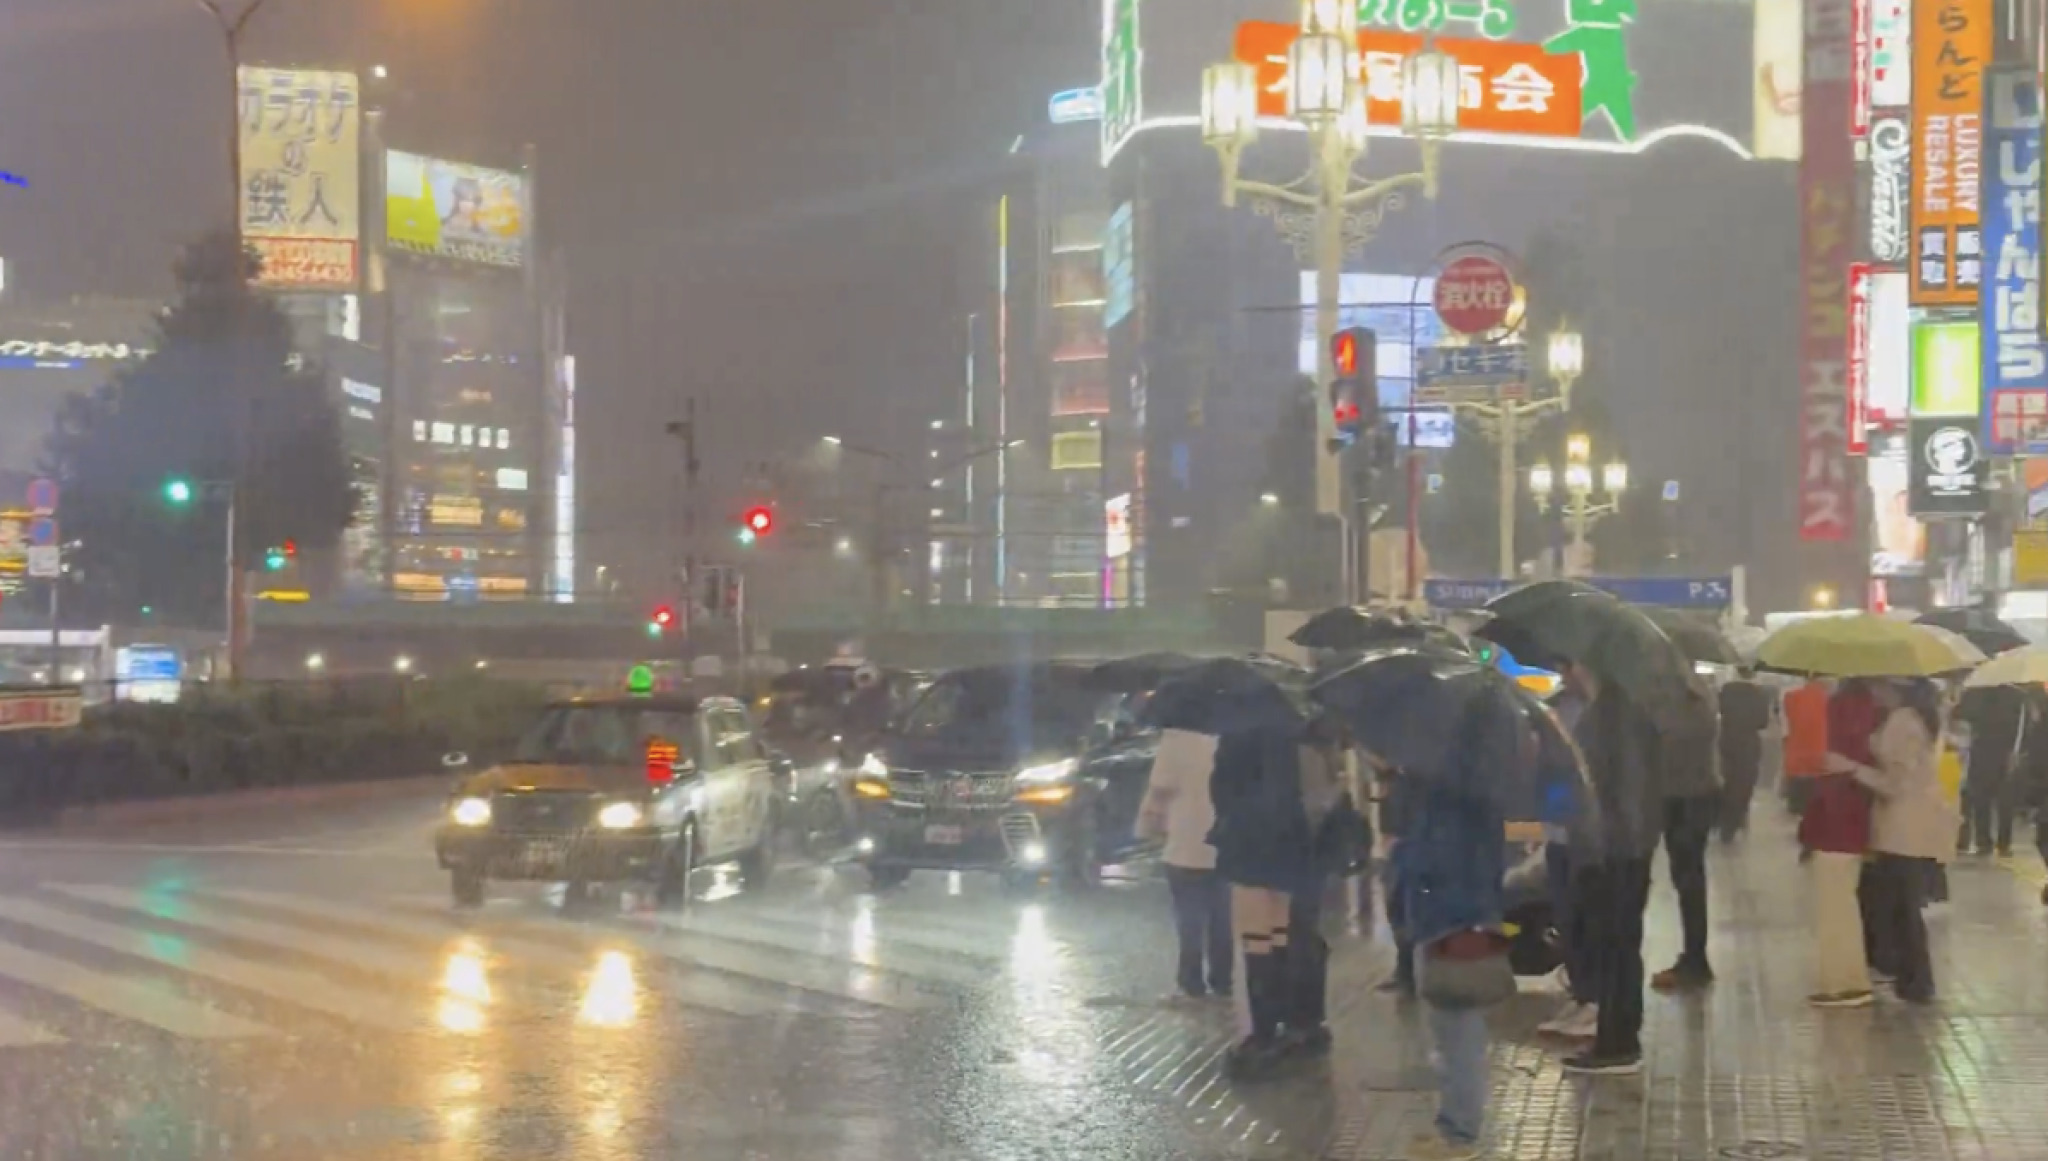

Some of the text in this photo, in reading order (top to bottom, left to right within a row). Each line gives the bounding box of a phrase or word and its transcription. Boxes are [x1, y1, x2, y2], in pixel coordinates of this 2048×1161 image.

[238, 76, 351, 142] カラオケ
[283, 138, 307, 176] の
[1924, 115, 1949, 212] RESALE
[1953, 113, 1978, 211] LUXURY
[247, 170, 339, 225] 鉄人
[1438, 278, 1509, 311] 消火栓
